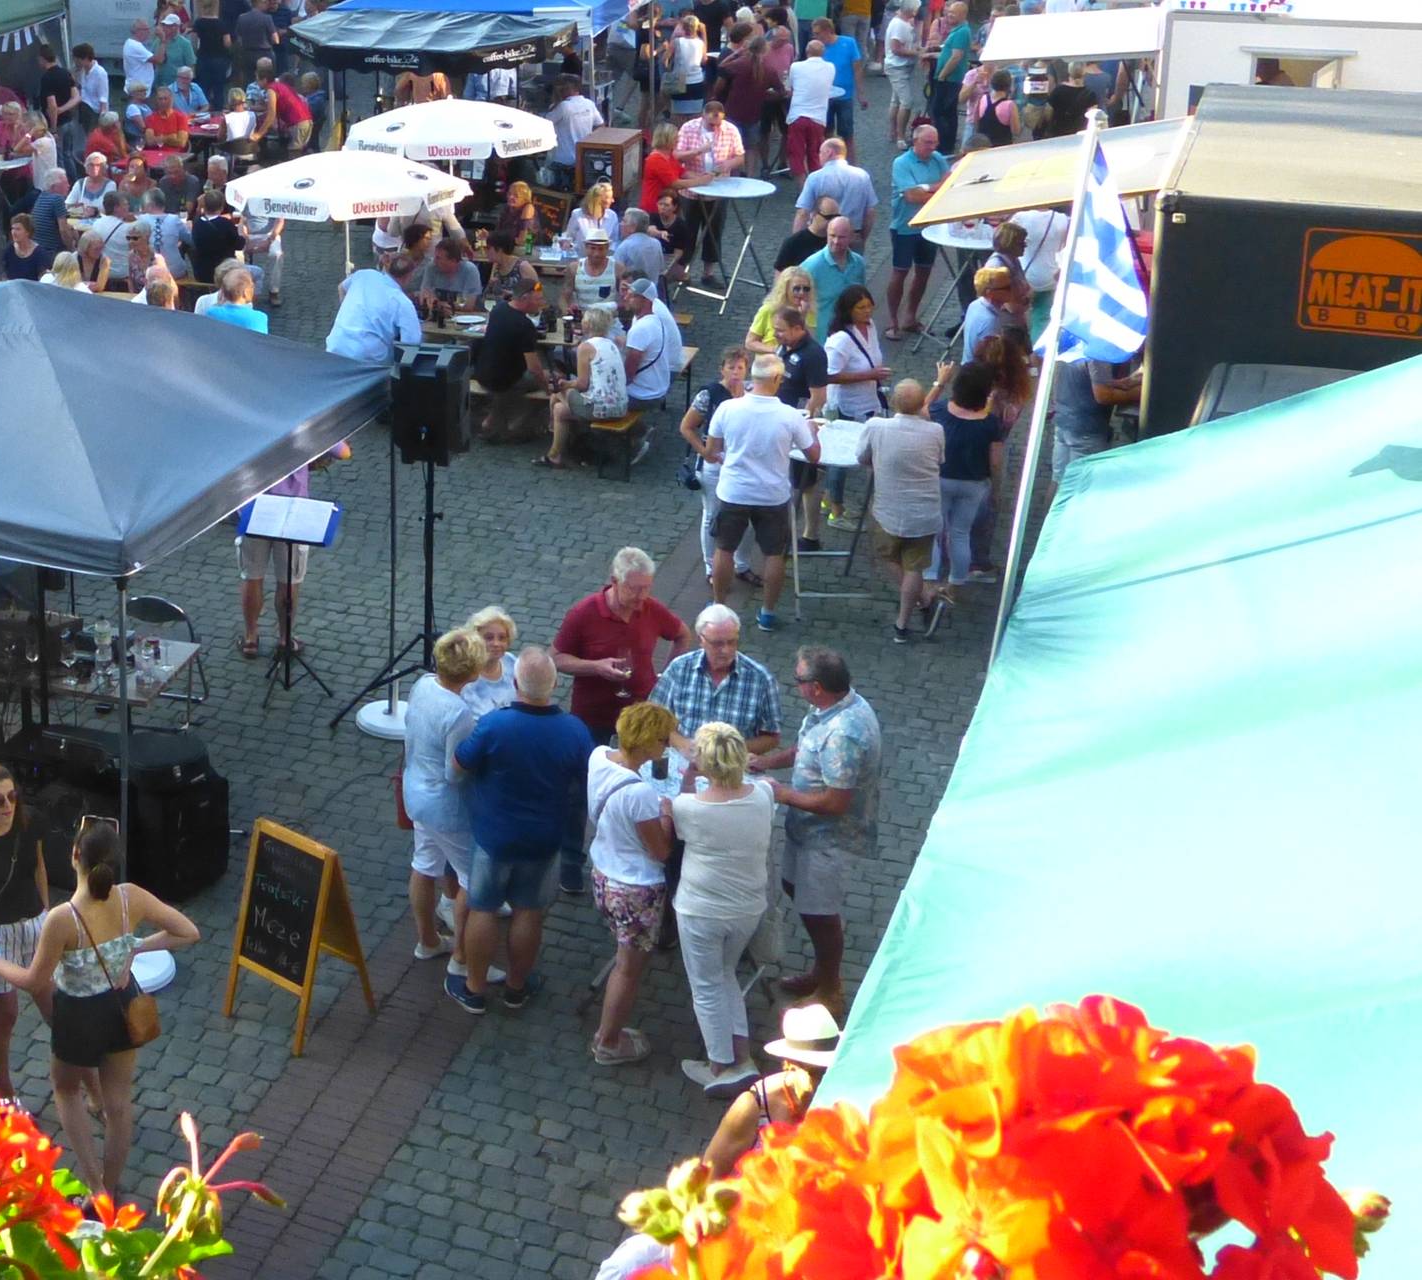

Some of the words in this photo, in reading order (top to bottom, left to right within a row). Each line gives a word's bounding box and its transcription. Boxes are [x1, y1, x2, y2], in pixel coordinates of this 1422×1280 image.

[428, 145, 472, 157] Weissbier
[263, 198, 318, 216] Benediktiner
[352, 201, 399, 215] Weissbier
[254, 904, 301, 949] Meze
